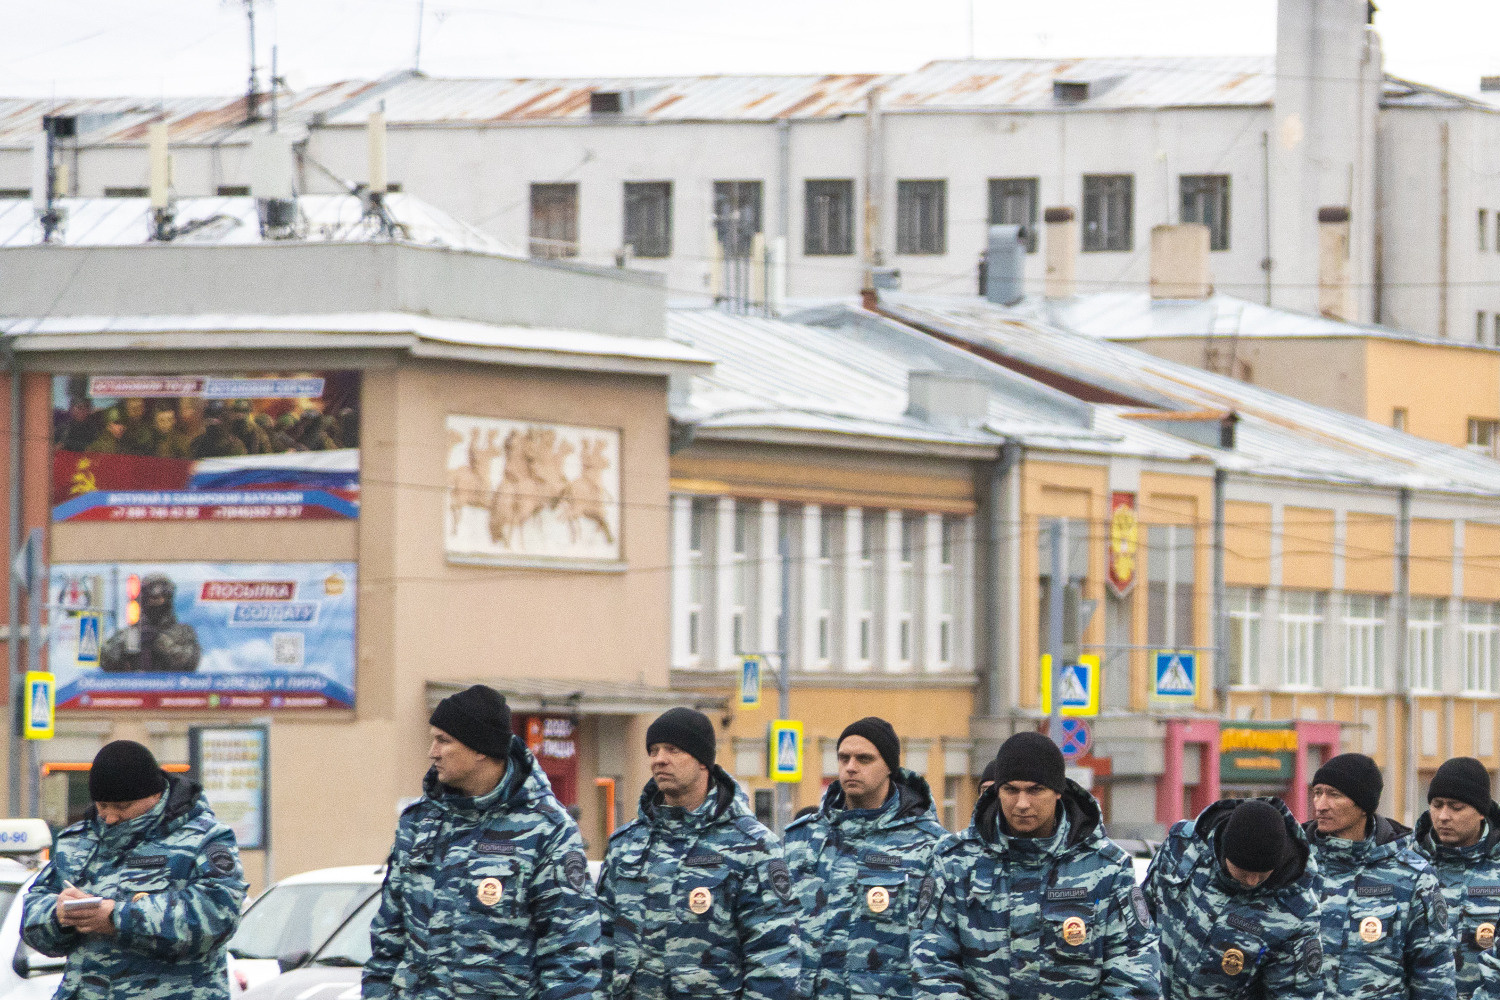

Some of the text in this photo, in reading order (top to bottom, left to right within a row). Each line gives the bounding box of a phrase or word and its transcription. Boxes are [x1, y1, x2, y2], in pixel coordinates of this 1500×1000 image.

[109, 492, 160, 504] ВСТУПАЙ
[173, 492, 241, 503] САМАРСКИЙ
[209, 585, 290, 599] ПОСЫЛКА
[240, 606, 312, 621] СОЛДАТУ
[0, 832, 27, 843] 0-90
[479, 843, 514, 852] ПОЛИЦИЯ
[867, 855, 900, 864] ПОЛИЦИЯ
[1049, 889, 1085, 899] ПОЛИЦИЯ
[1358, 885, 1392, 895] ПОЛИЦИЯ
